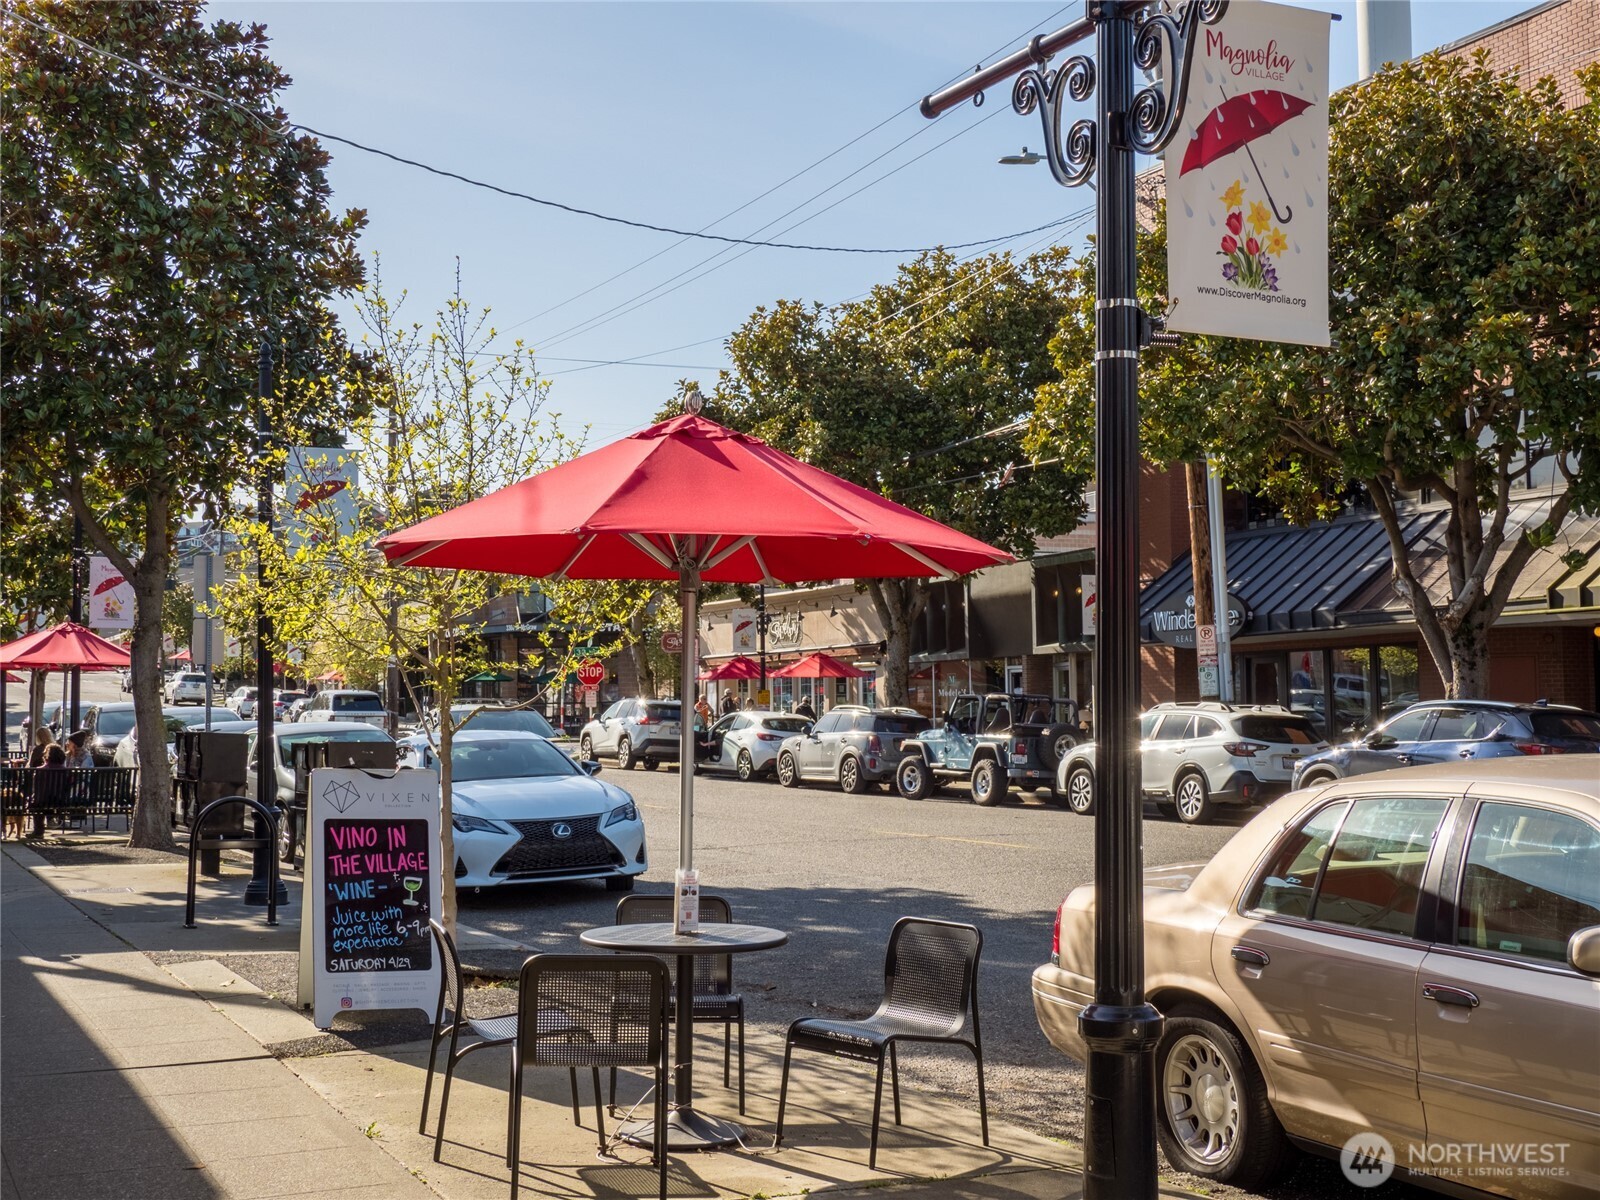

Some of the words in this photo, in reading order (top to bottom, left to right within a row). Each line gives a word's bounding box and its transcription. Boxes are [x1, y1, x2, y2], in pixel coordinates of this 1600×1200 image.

[1206, 28, 1295, 76] Magnolia
[1245, 67, 1285, 82] VILLAGE
[1197, 286, 1307, 307] www.DiscoverMagnolia.org
[1175, 634, 1193, 643] REAL
[579, 666, 603, 678] STOP
[366, 792, 430, 802] VIXEN
[330, 826, 378, 851] VINO
[387, 825, 407, 851] IN
[328, 854, 362, 877] THE
[364, 852, 428, 874] VILLAGE
[332, 905, 370, 925] Juice
[372, 905, 403, 921] with
[333, 925, 367, 939] more
[368, 921, 392, 936] life
[330, 957, 386, 972] SATURDAY
[388, 956, 412, 970] 4/29
